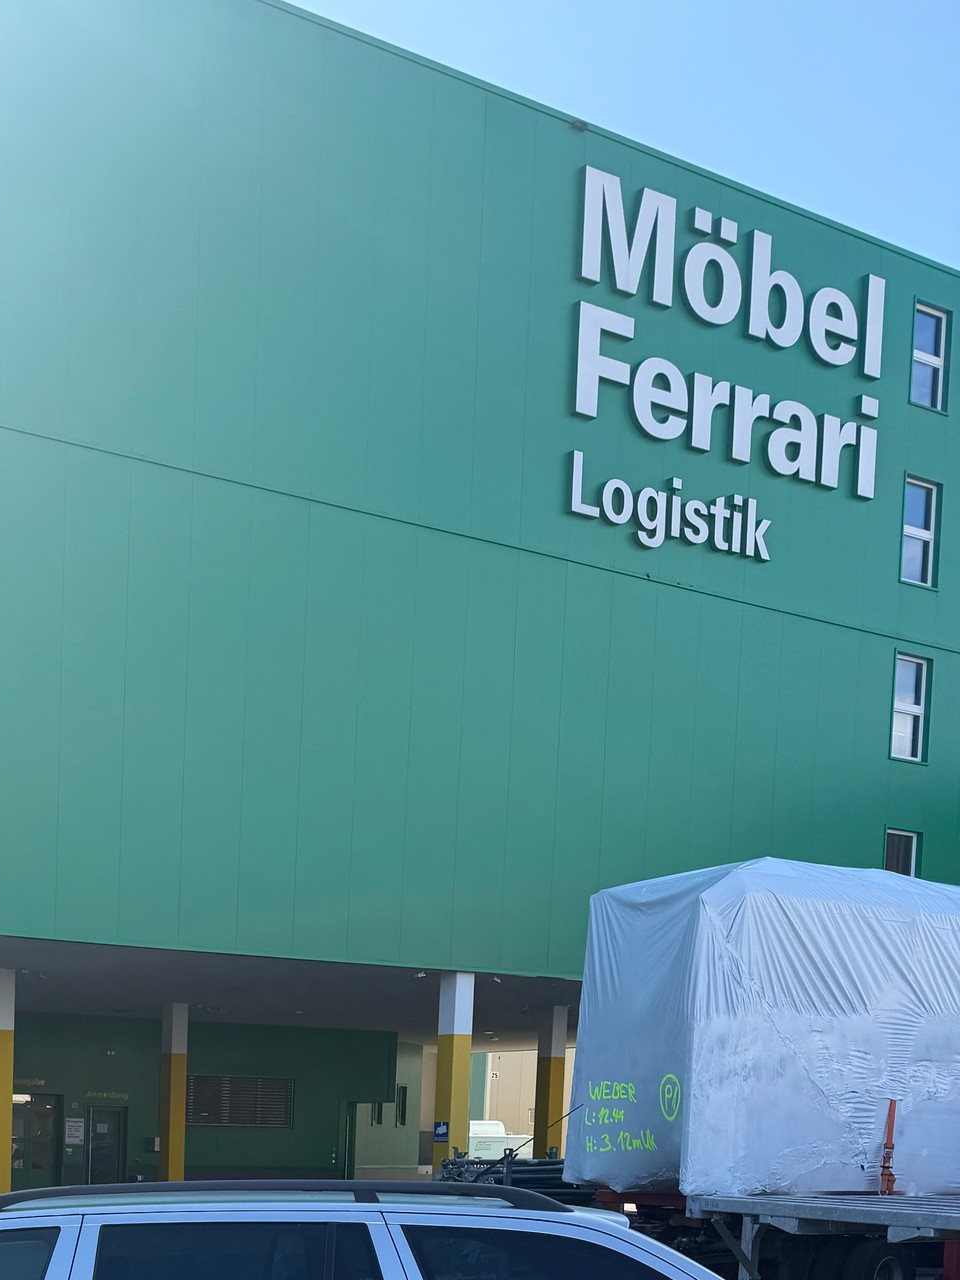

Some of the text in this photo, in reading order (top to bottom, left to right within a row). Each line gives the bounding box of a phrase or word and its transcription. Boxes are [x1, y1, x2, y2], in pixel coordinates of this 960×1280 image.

[580, 165, 886, 380] Möbel
[574, 300, 879, 500] Ferrari
[570, 450, 772, 562] Logistik
[86, 1090, 129, 1101] Anmeldung
[588, 1081, 637, 1103] WEBER
